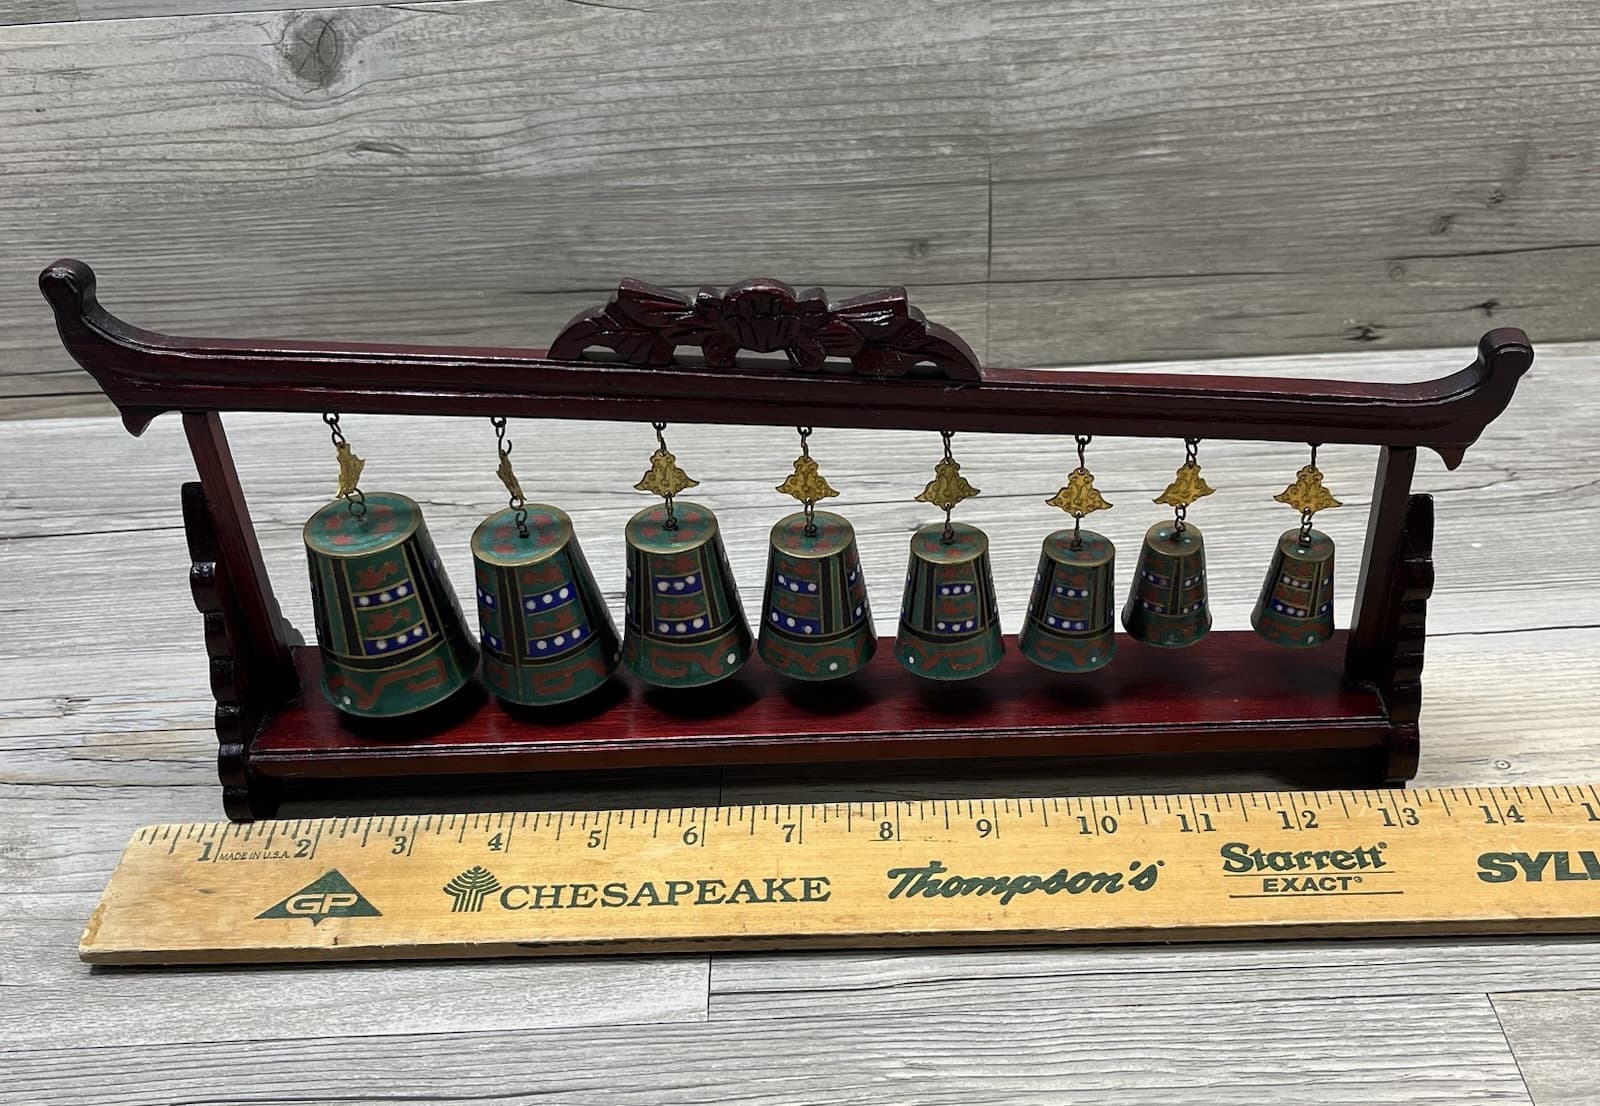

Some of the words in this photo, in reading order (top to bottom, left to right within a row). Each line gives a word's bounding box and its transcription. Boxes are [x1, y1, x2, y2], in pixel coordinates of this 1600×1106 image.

[198, 842, 213, 861] 1
[294, 838, 311, 858] 2
[391, 836, 407, 855] 3
[487, 832, 503, 851] 4
[587, 830, 601, 848] 5
[682, 826, 698, 845] 6
[782, 824, 796, 842] 7
[879, 821, 893, 840] 8
[976, 819, 992, 838] 9
[1078, 815, 1118, 835] 10
[1177, 813, 1216, 832] 11
[1277, 810, 1319, 830] 12
[1377, 808, 1420, 828] 13
[1478, 804, 1525, 824] 14
[219, 852, 248, 861] MADE
[249, 851, 261, 860] IN
[1220, 842, 1387, 872] Starrett
[500, 876, 832, 910] CHESAPEAKE
[887, 861, 1164, 906] Thompson's
[1262, 877, 1353, 893] EXACT
[285, 893, 359, 915] GP
